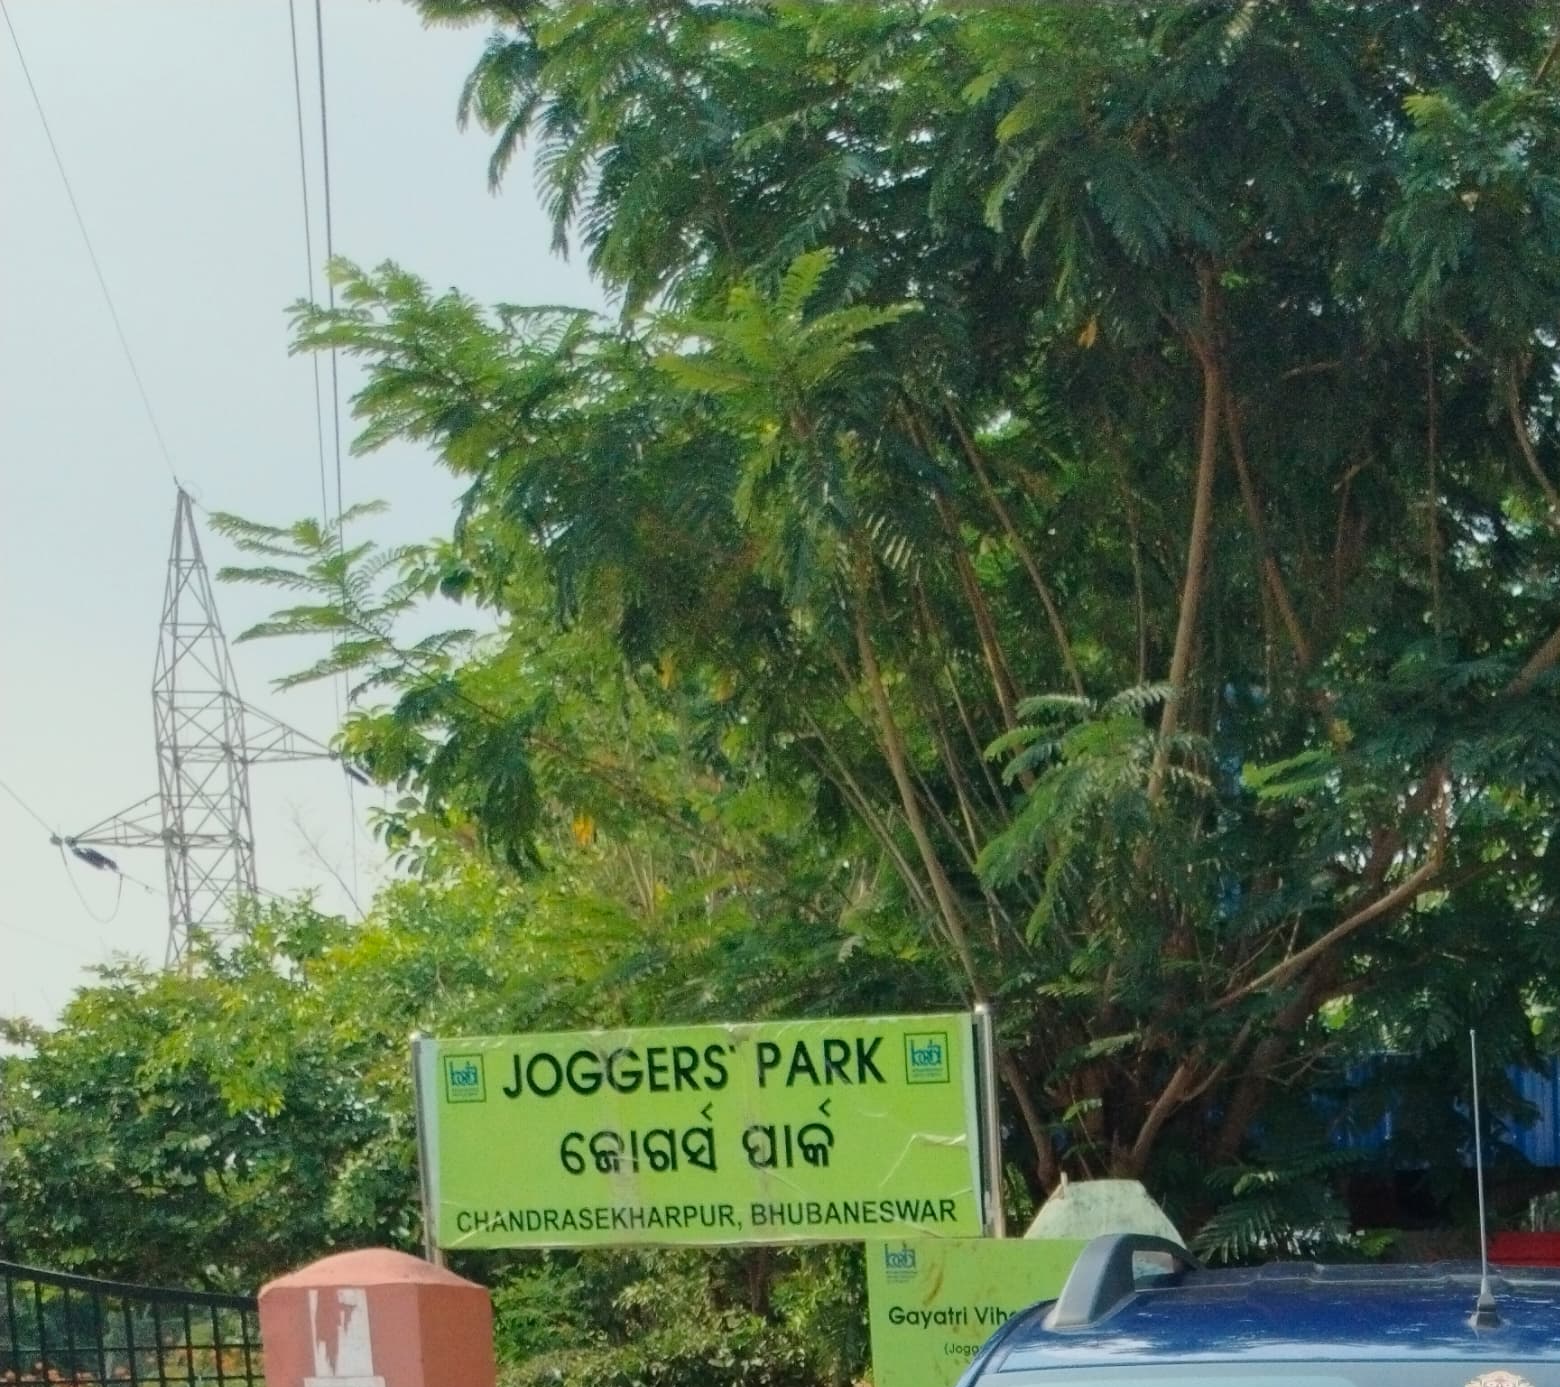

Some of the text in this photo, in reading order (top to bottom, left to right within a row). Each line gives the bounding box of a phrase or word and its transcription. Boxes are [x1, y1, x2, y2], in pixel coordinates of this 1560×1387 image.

[503, 1036, 887, 1098] JOGGERS' PARK
[742, 1098, 834, 1169] ପାର୍କ
[456, 1199, 958, 1232] CHANDRASEKHARPUR, BHUBANESWAR
[888, 1306, 1017, 1329] Gayatri Vih
